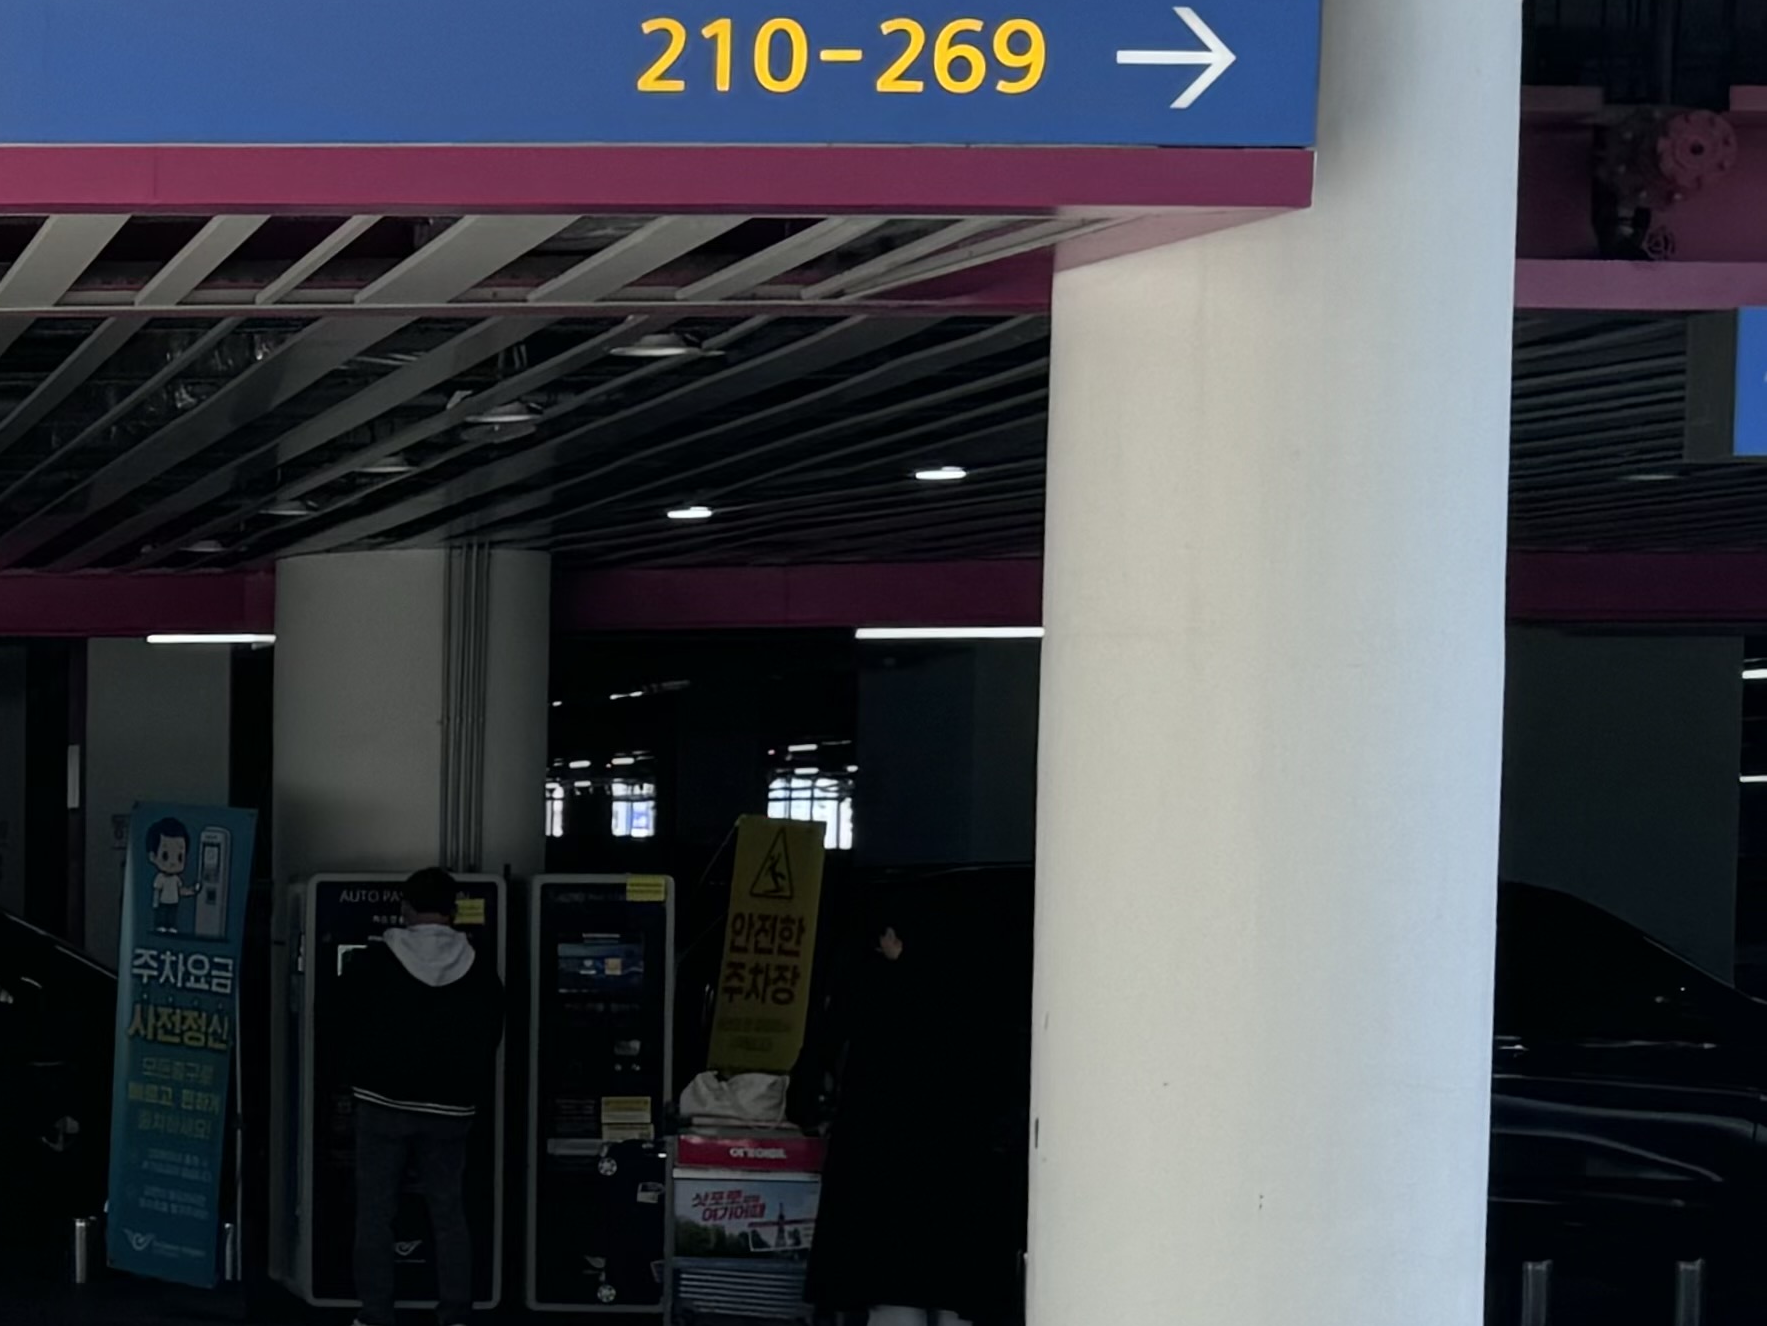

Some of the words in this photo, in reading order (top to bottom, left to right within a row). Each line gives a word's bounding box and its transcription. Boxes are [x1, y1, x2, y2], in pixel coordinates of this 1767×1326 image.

[636, 17, 1047, 95] 210-269
[339, 889, 380, 903] AUTO
[729, 911, 806, 958] 안전한
[131, 946, 235, 995] 주차요금
[721, 961, 802, 1006] 주차장
